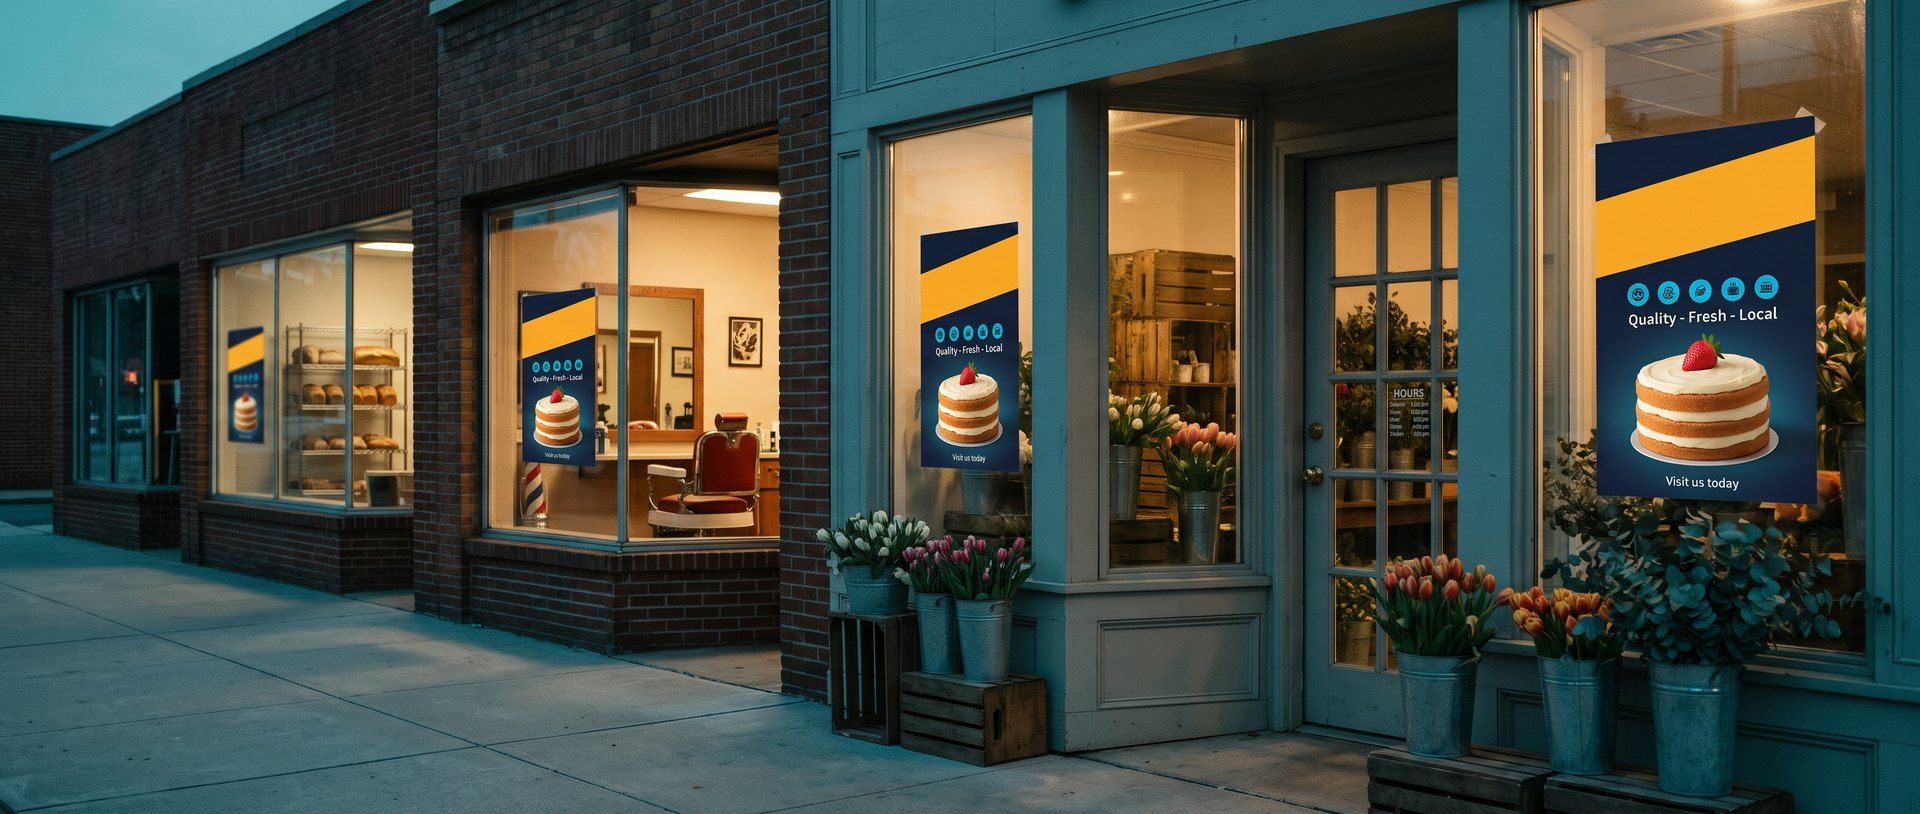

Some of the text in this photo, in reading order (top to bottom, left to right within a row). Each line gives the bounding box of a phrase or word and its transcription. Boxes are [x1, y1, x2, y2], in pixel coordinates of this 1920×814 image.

[1628, 312, 1677, 328] Quality
[1688, 309, 1727, 323] Fresh
[1739, 306, 1778, 321] Local
[935, 346, 958, 357] Quality
[962, 345, 980, 354] Fresh
[985, 342, 1003, 352] Local
[532, 375, 550, 383] Quality
[1393, 388, 1424, 398] HOURS
[971, 454, 986, 464] today
[1665, 476, 1739, 491] Visit us today
